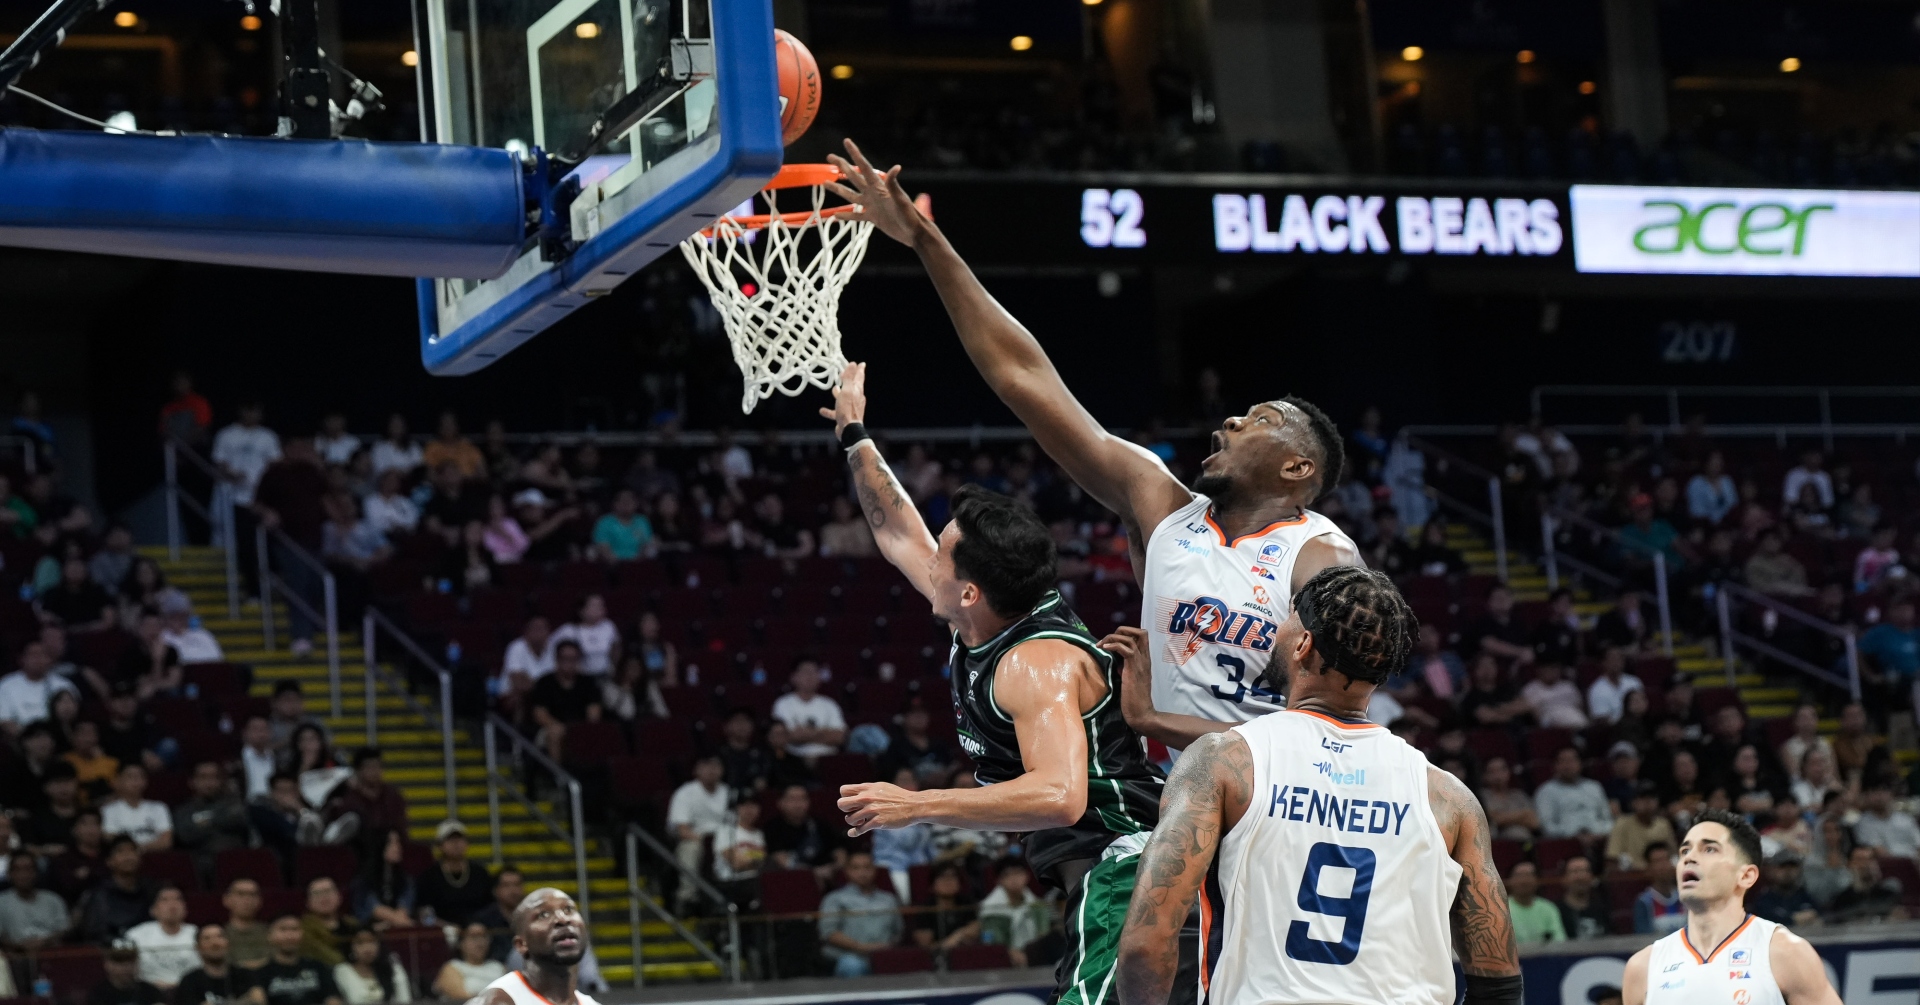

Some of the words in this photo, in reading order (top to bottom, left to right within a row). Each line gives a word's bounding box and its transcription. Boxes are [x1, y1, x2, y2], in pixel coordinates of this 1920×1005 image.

[1080, 188, 1146, 248] 52
[1213, 194, 1390, 252] BLACK
[1397, 197, 1562, 255] BEARS
[1633, 201, 1834, 255] acer
[1662, 321, 1736, 362] 207
[1259, 554, 1278, 564] EASL
[1168, 594, 1279, 653] BOLTS
[1242, 602, 1273, 617] MERALCO
[1210, 653, 1282, 704] 34
[1268, 784, 1410, 836] KENNEDY
[1285, 842, 1377, 965] 9
